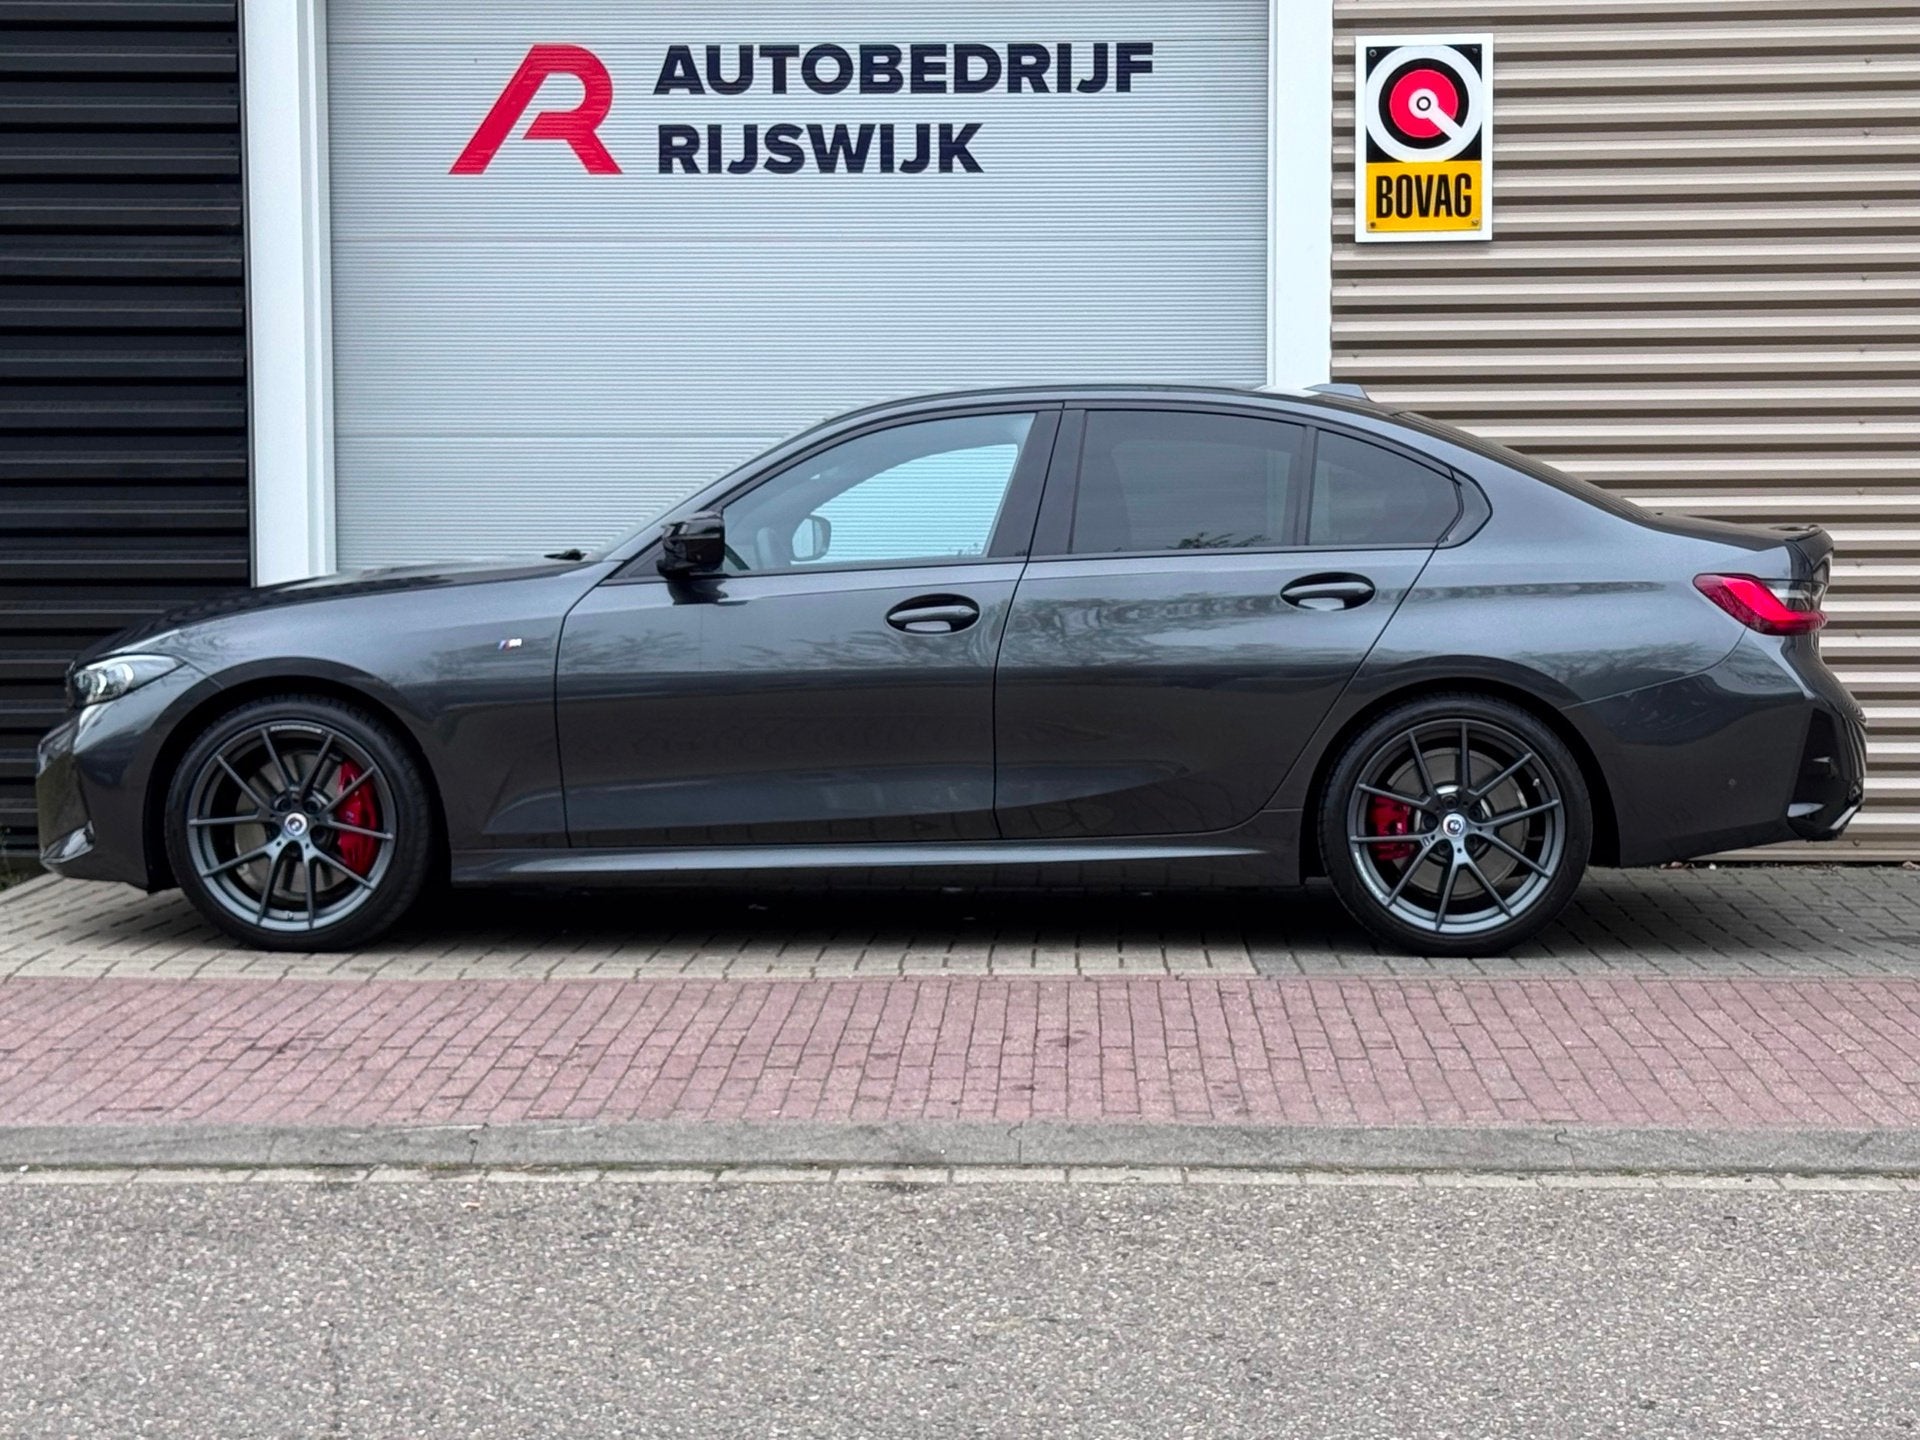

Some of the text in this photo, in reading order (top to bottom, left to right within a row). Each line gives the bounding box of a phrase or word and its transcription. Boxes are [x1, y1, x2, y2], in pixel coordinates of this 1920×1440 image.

[653, 42, 1154, 96] AUTOBEDRIJF
[658, 122, 984, 175] RIJSWIJK
[1375, 173, 1473, 219] BOVAG
